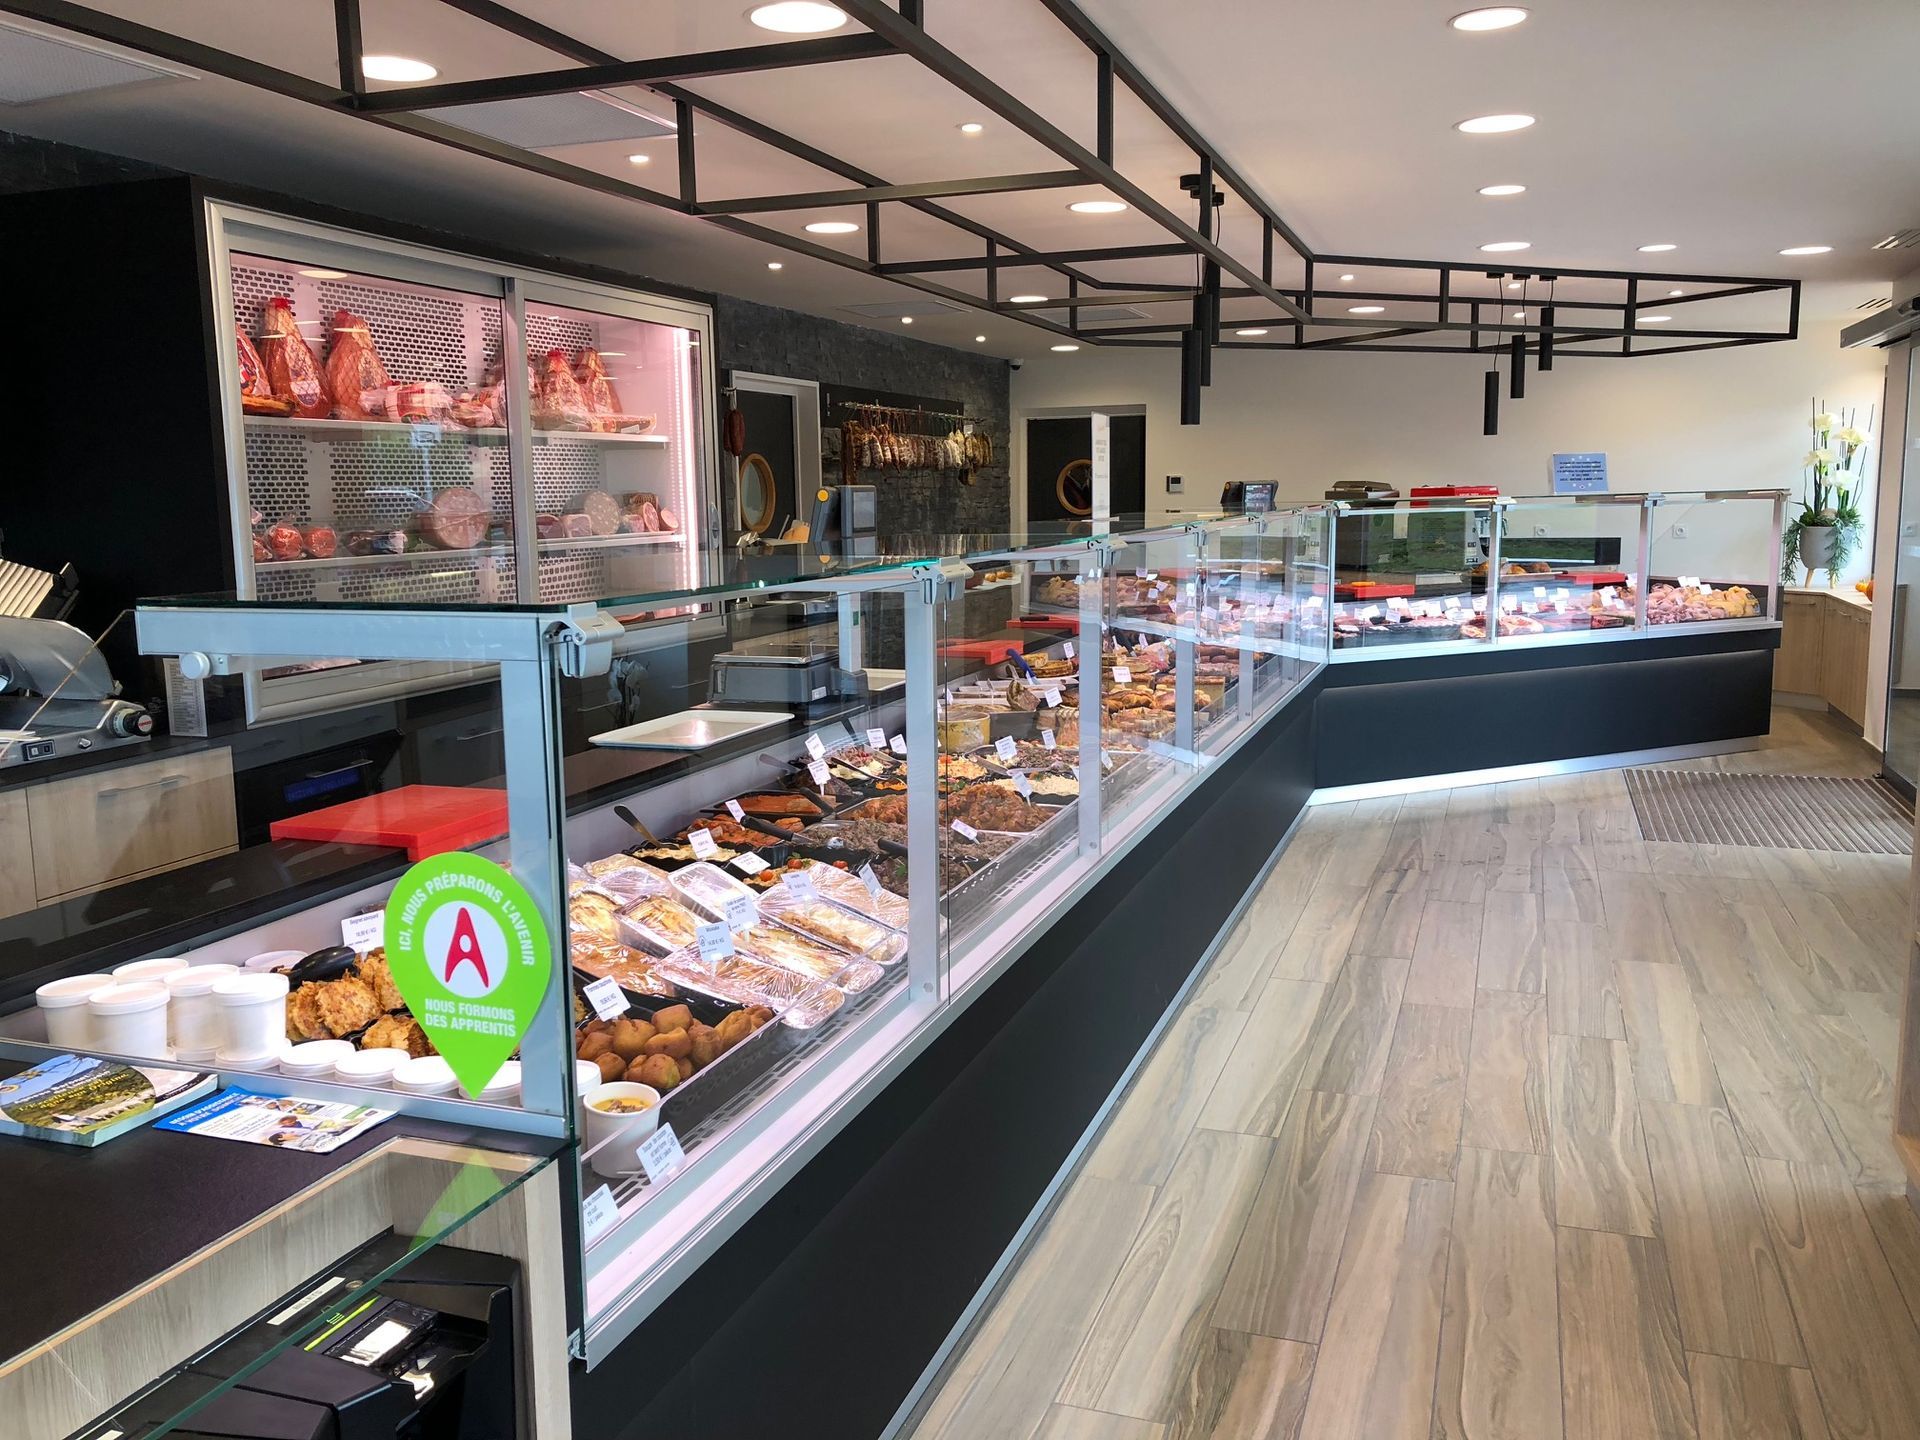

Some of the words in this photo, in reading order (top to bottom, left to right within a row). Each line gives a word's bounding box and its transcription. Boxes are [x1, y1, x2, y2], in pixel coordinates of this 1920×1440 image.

[424, 871, 504, 904] PRÉPARONS
[401, 889, 428, 926] NOUS
[399, 929, 413, 951] ICI,
[501, 900, 535, 966] L'AVENIR
[425, 998, 456, 1014] NOUS
[458, 1002, 515, 1021] FORMONS
[425, 1013, 448, 1028] DES
[450, 1017, 516, 1037] APPRENTIS
